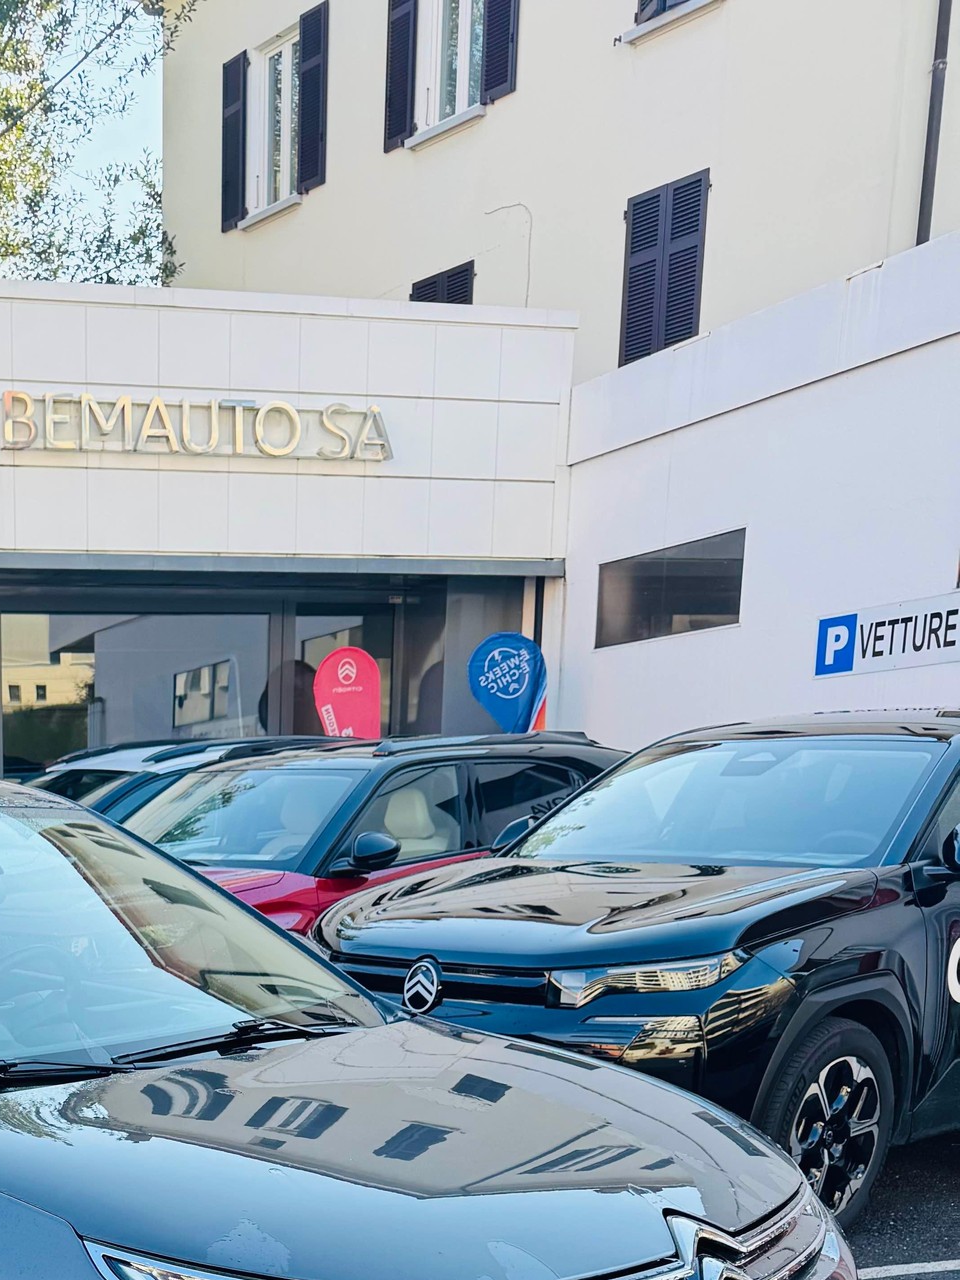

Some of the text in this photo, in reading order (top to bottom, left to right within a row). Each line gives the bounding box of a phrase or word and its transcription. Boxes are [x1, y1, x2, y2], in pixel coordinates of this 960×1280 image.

[1, 390, 394, 461] BEMAUTO SA
[824, 609, 959, 666] P VETTURE
